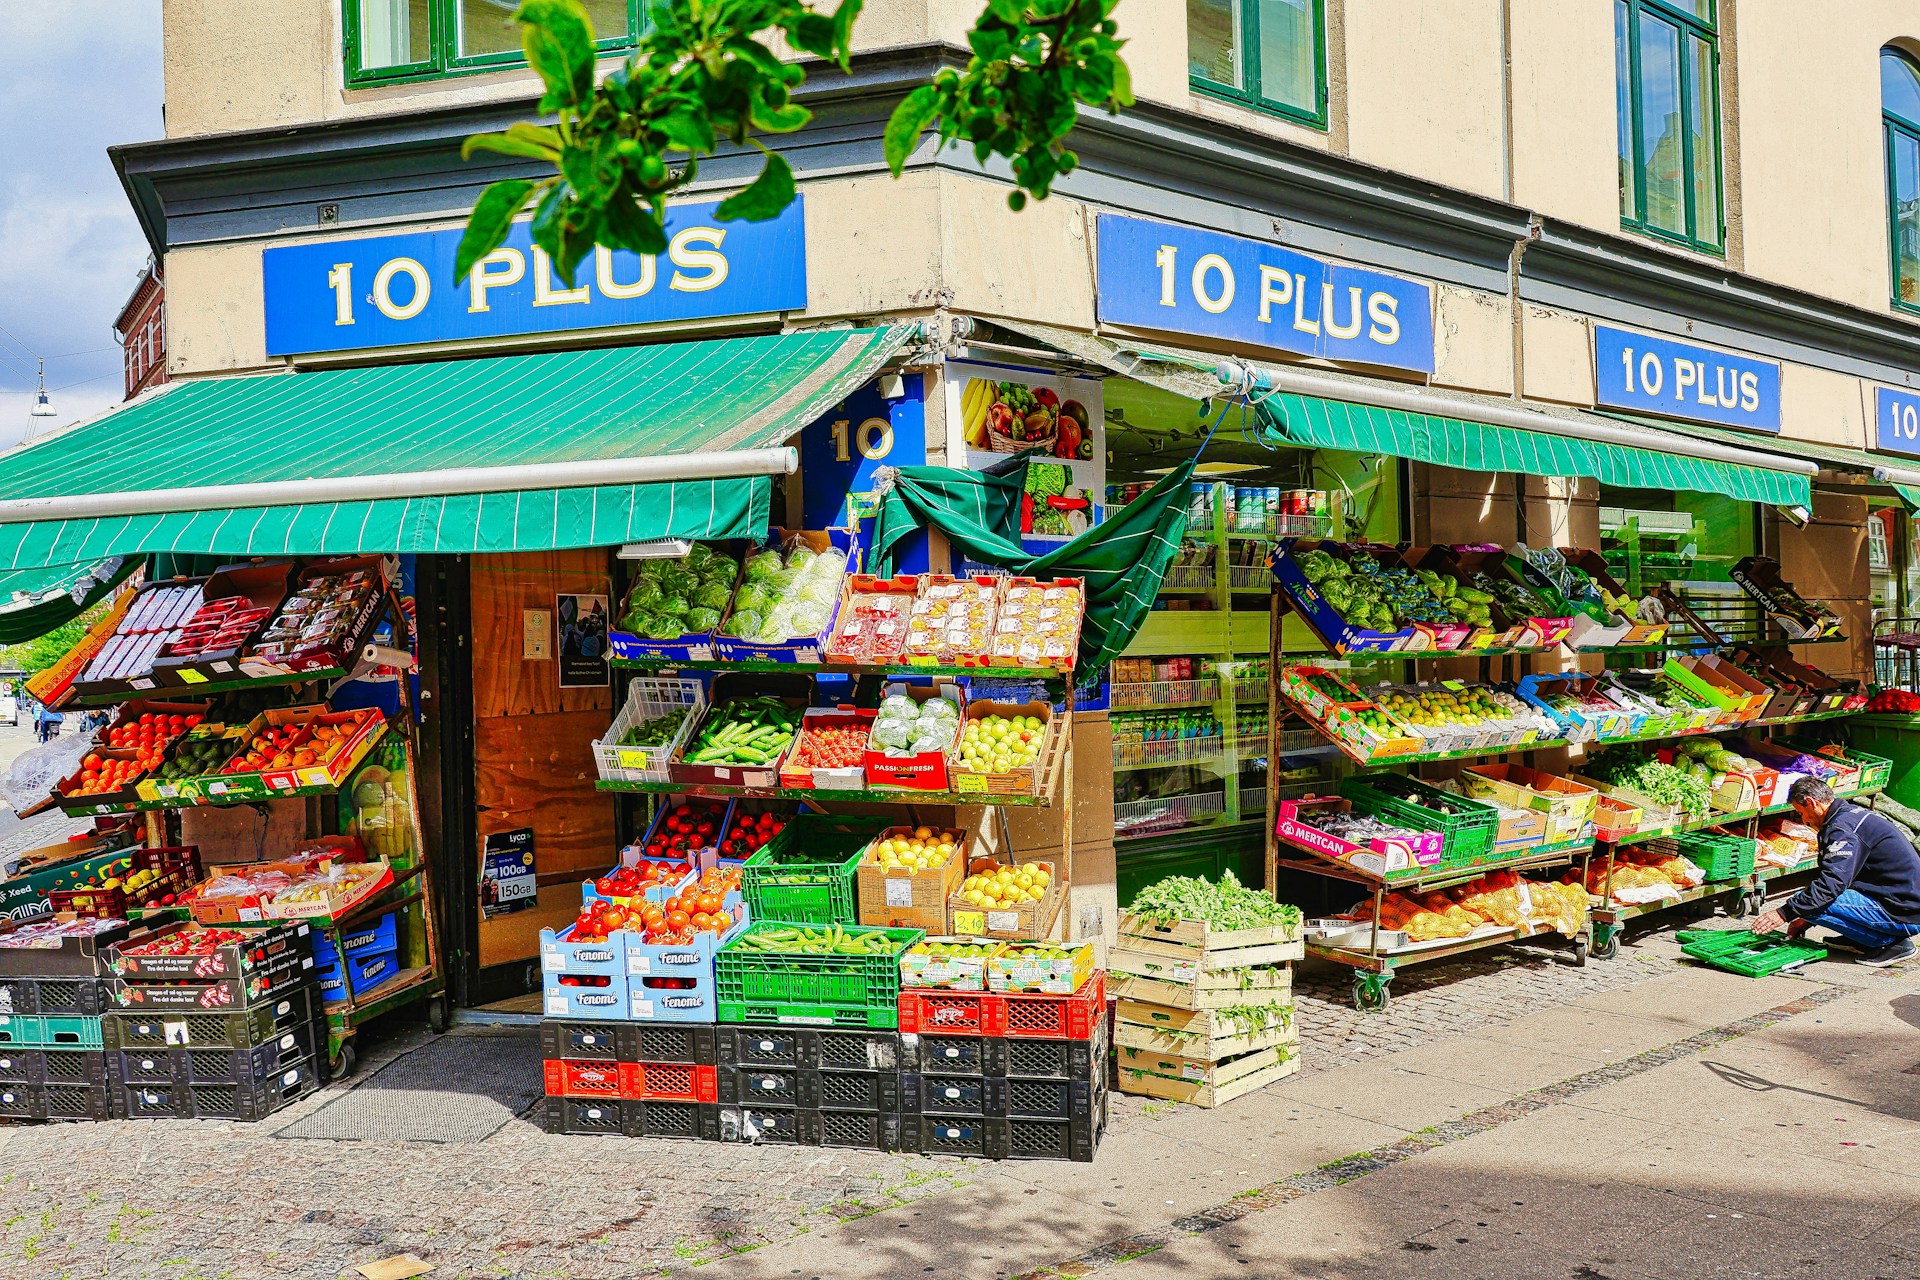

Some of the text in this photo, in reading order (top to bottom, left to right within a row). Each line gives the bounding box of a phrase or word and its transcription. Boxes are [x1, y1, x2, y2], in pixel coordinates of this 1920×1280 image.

[327, 225, 729, 327] 10 PLUS
[1155, 244, 1400, 346] 10 PLUS
[1622, 346, 1760, 413] 10 PLUS
[1891, 400, 1918, 440] 10
[831, 416, 894, 462] 10
[1742, 579, 1778, 612] MERTCAN
[352, 590, 381, 638] MERTCAN
[874, 763, 934, 773] PASSIONFRESH
[510, 833, 527, 843] Lyca
[1295, 827, 1344, 855] MERTCAN
[1418, 852, 1441, 862] MERTCAN
[499, 864, 527, 877] 100GB
[8, 884, 32, 898] Xeed
[353, 880, 372, 898] MERTCAN
[501, 884, 531, 897] 150GB
[298, 904, 327, 913] MERTCAN
[335, 930, 376, 951] enomé
[574, 948, 614, 961] Fenomé
[659, 951, 700, 965] Fenomé
[362, 958, 386, 980] Fenomé
[577, 992, 616, 1006] Fenomé
[663, 994, 704, 1009] Fenomé
